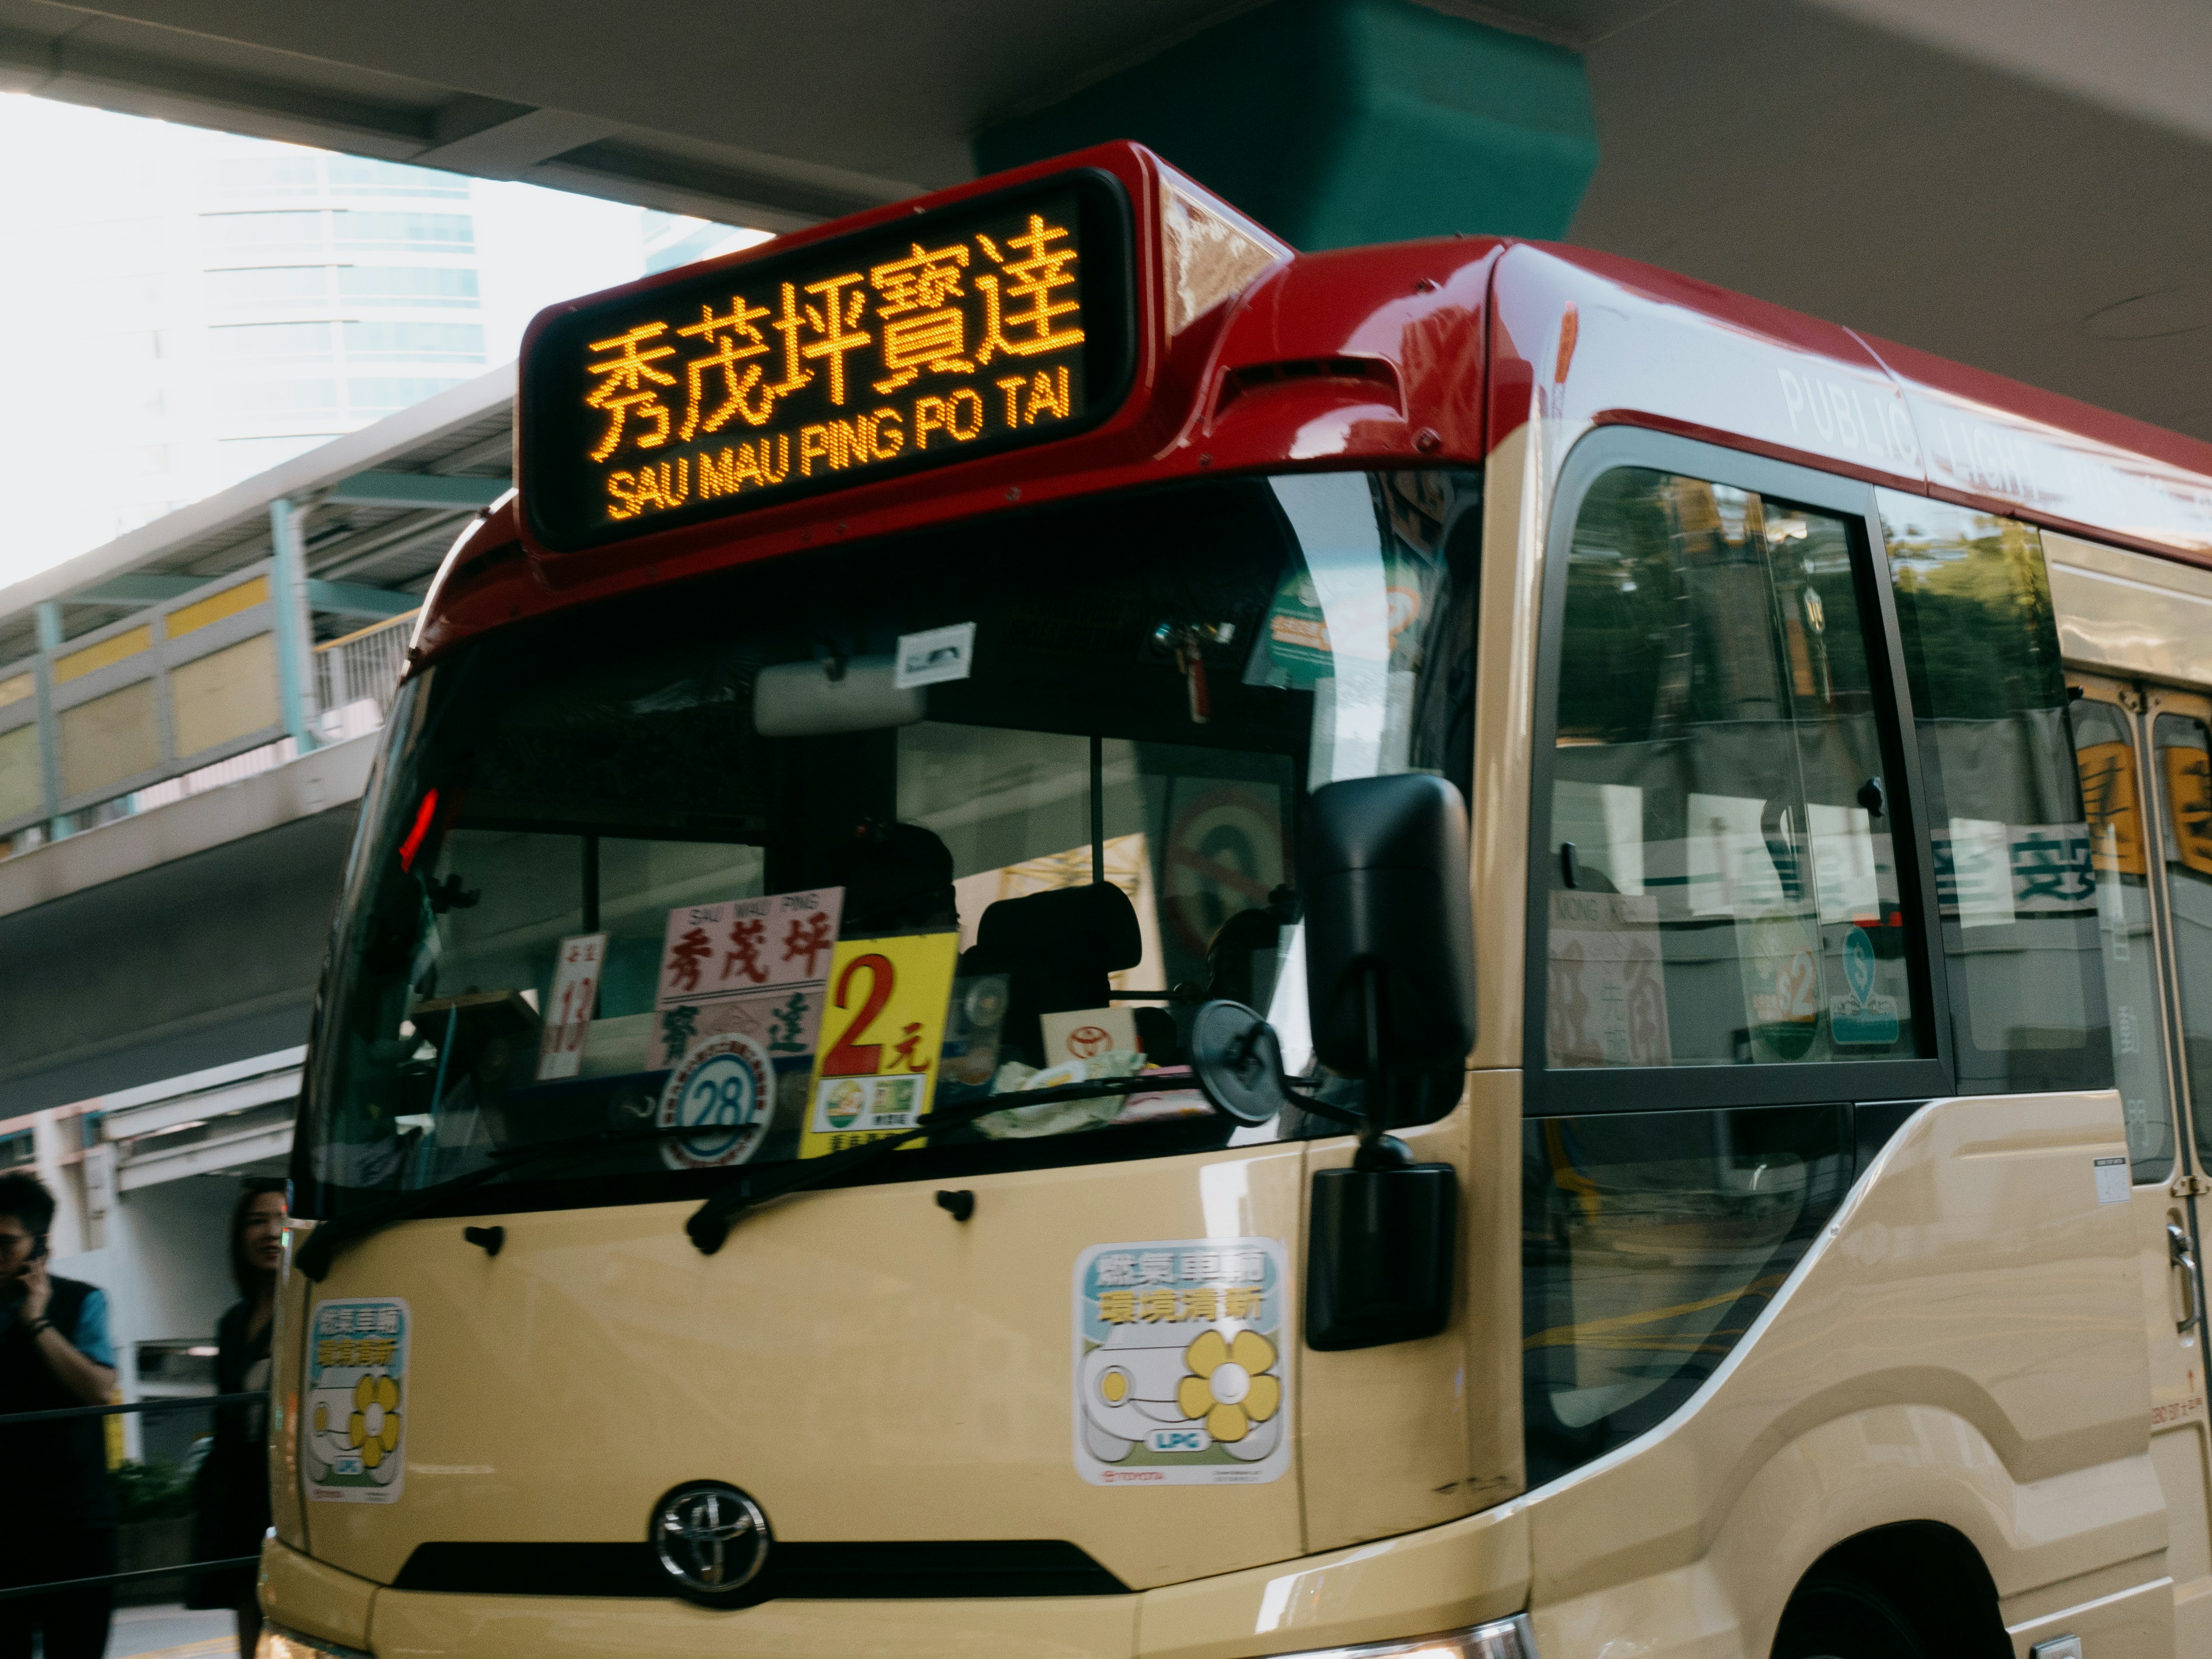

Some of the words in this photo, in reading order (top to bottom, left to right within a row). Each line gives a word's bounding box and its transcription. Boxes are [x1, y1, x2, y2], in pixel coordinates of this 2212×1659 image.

[608, 458, 689, 520] SAU
[700, 434, 790, 499] MAU
[800, 407, 905, 477] PING
[915, 388, 983, 450] PO
[1776, 366, 1921, 463] PUBLIC
[1939, 415, 2041, 501] LIGHT
[693, 1076, 743, 1127] 28
[1156, 1432, 1201, 1449] LPG
